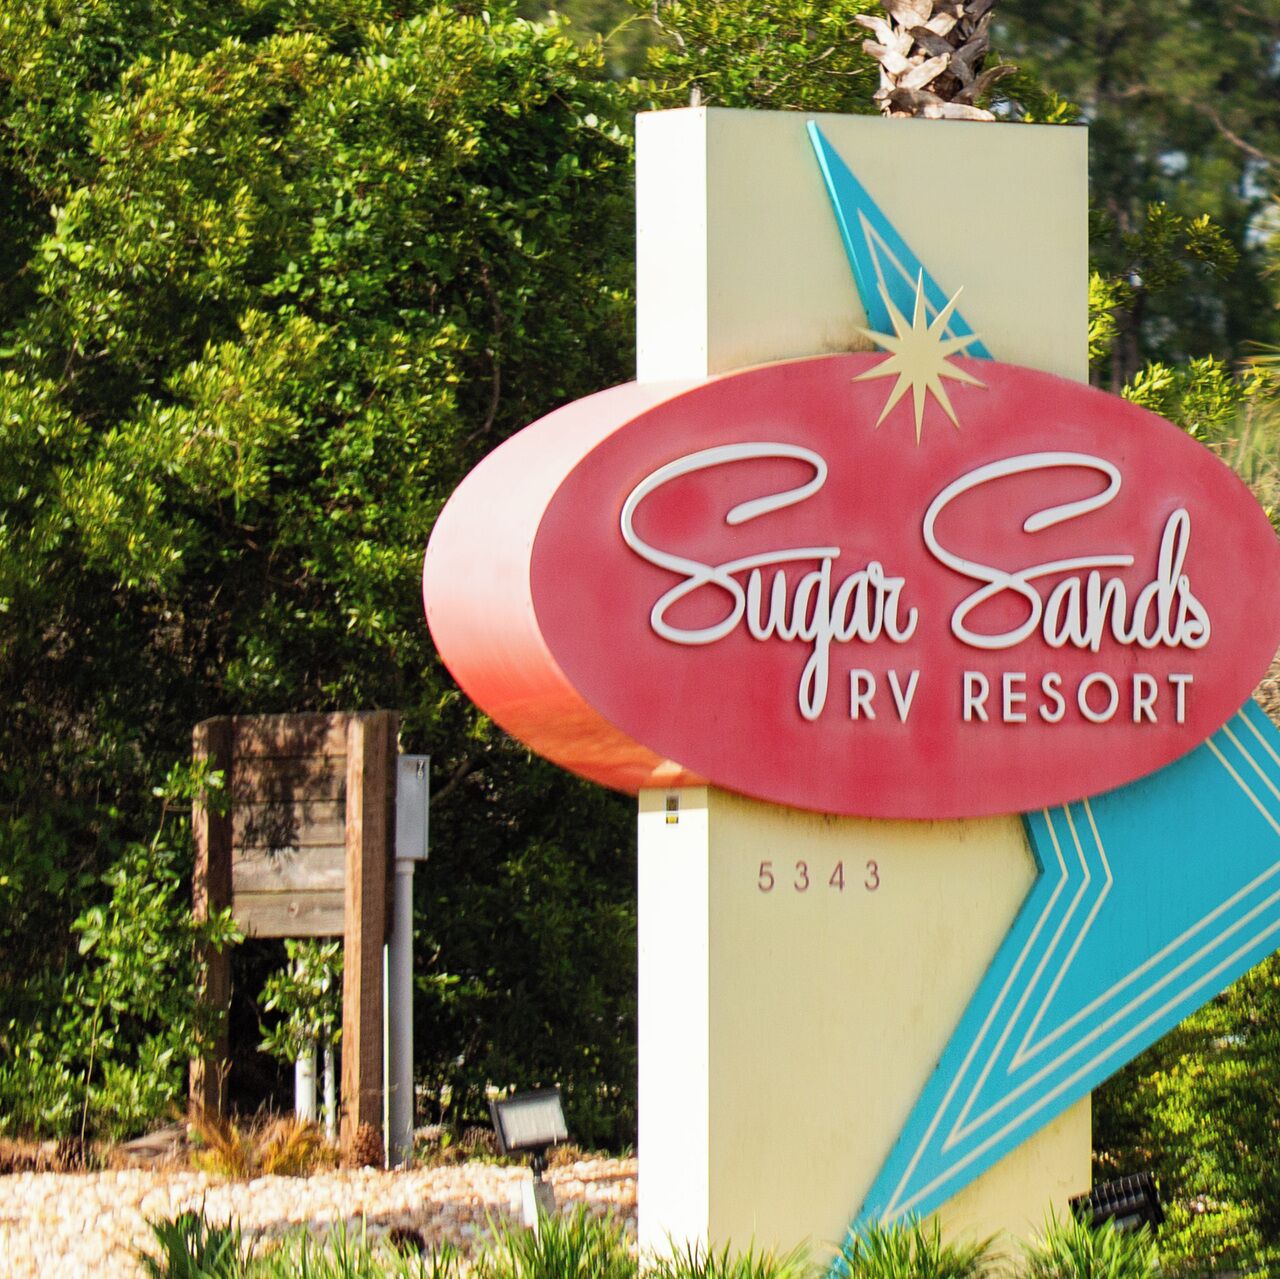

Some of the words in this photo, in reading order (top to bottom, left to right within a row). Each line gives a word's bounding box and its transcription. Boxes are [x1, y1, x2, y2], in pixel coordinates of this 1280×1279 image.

[620, 441, 919, 721] Sugar
[922, 451, 1211, 653] Sands
[850, 668, 920, 723] RV
[963, 670, 1194, 723] RESORT
[757, 859, 880, 892] 5343
